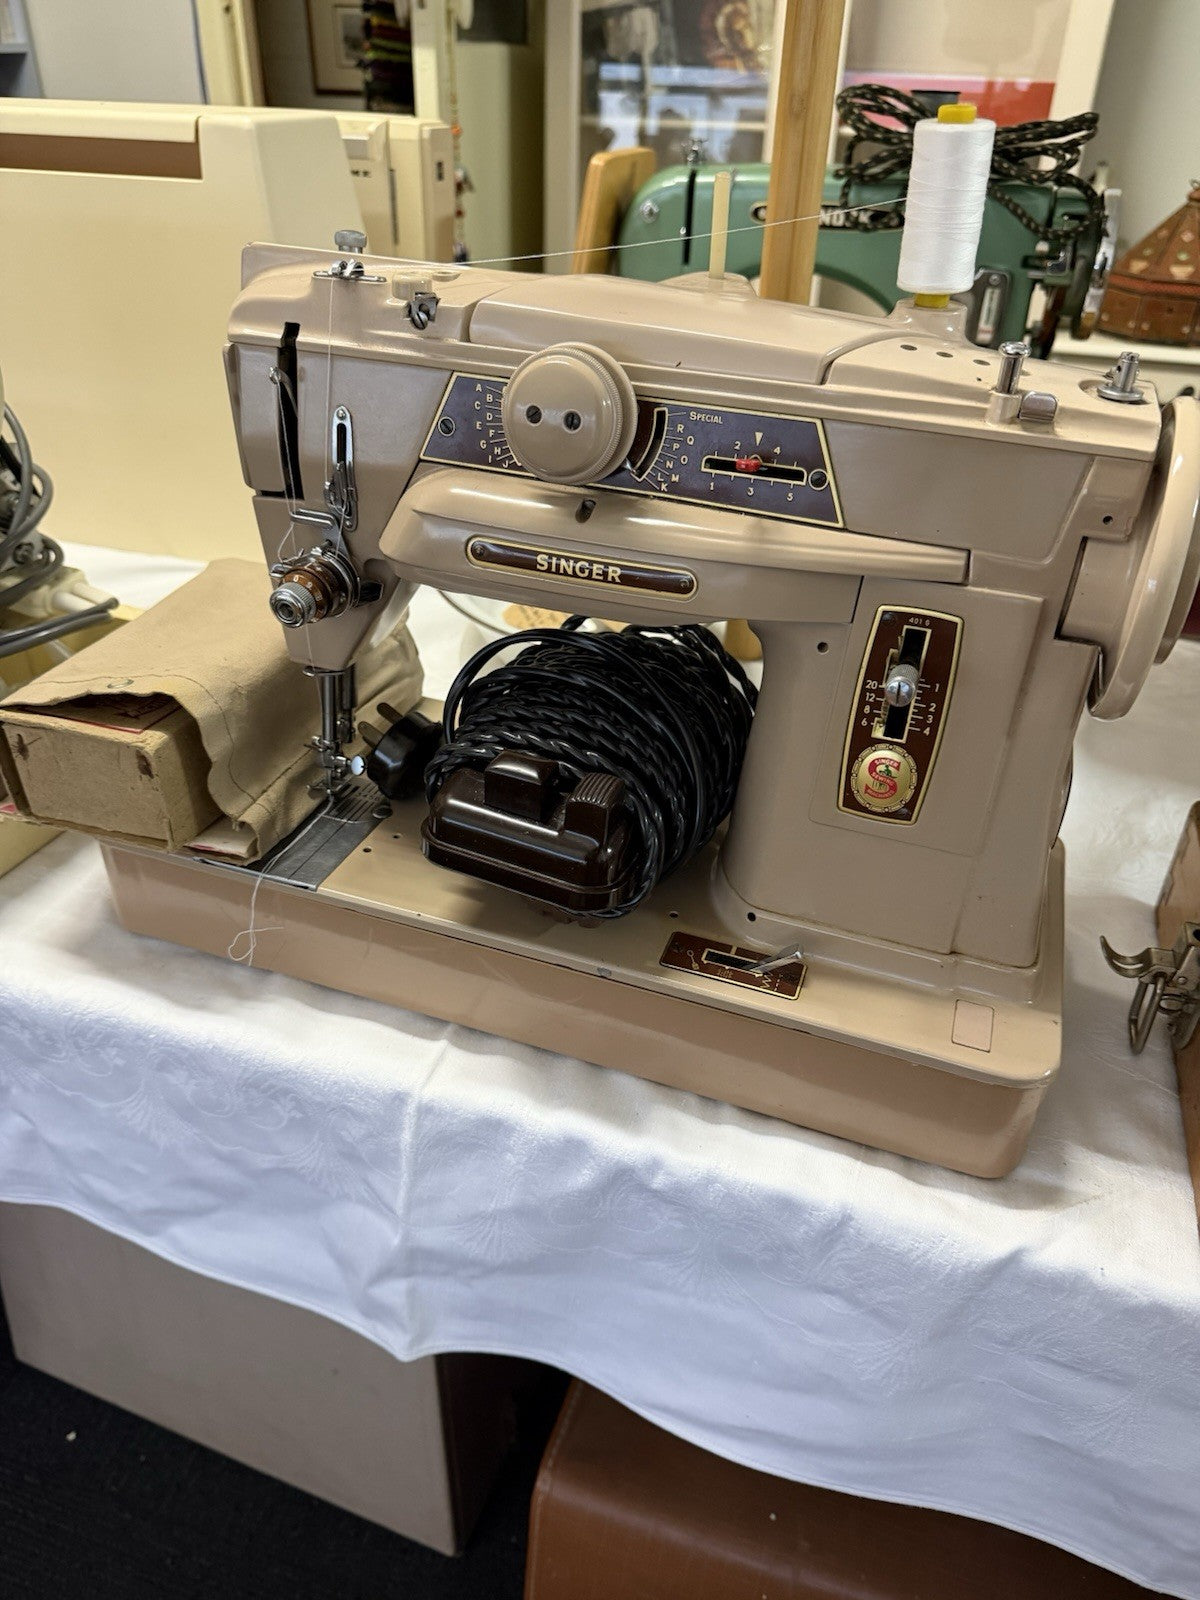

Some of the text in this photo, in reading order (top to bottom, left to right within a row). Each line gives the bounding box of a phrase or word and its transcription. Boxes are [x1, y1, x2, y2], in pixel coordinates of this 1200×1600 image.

[476, 384, 482, 392] A
[486, 394, 493, 402] B
[474, 401, 481, 410] C
[486, 413, 493, 421] D
[476, 421, 482, 430] E
[677, 424, 685, 433] R
[489, 429, 495, 437] F
[480, 440, 487, 449] G
[687, 436, 695, 445] Q
[673, 443, 680, 451] P
[734, 441, 741, 450] 2
[494, 446, 501, 455] H
[773, 446, 781, 455] 4
[502, 460, 509, 468] J
[666, 460, 674, 469] N
[657, 473, 664, 482] L
[671, 474, 680, 482] M
[660, 483, 668, 492] K
[709, 482, 714, 490] 1
[747, 487, 754, 496] 3
[787, 492, 794, 501] 5
[536, 553, 622, 583] SINGER
[865, 680, 878, 690] 20
[934, 683, 940, 692] 1
[865, 692, 875, 702] 12
[863, 704, 871, 714] 8
[929, 703, 937, 712] 2
[861, 717, 868, 727] 6
[926, 715, 934, 724] 3
[923, 727, 931, 736] 4
